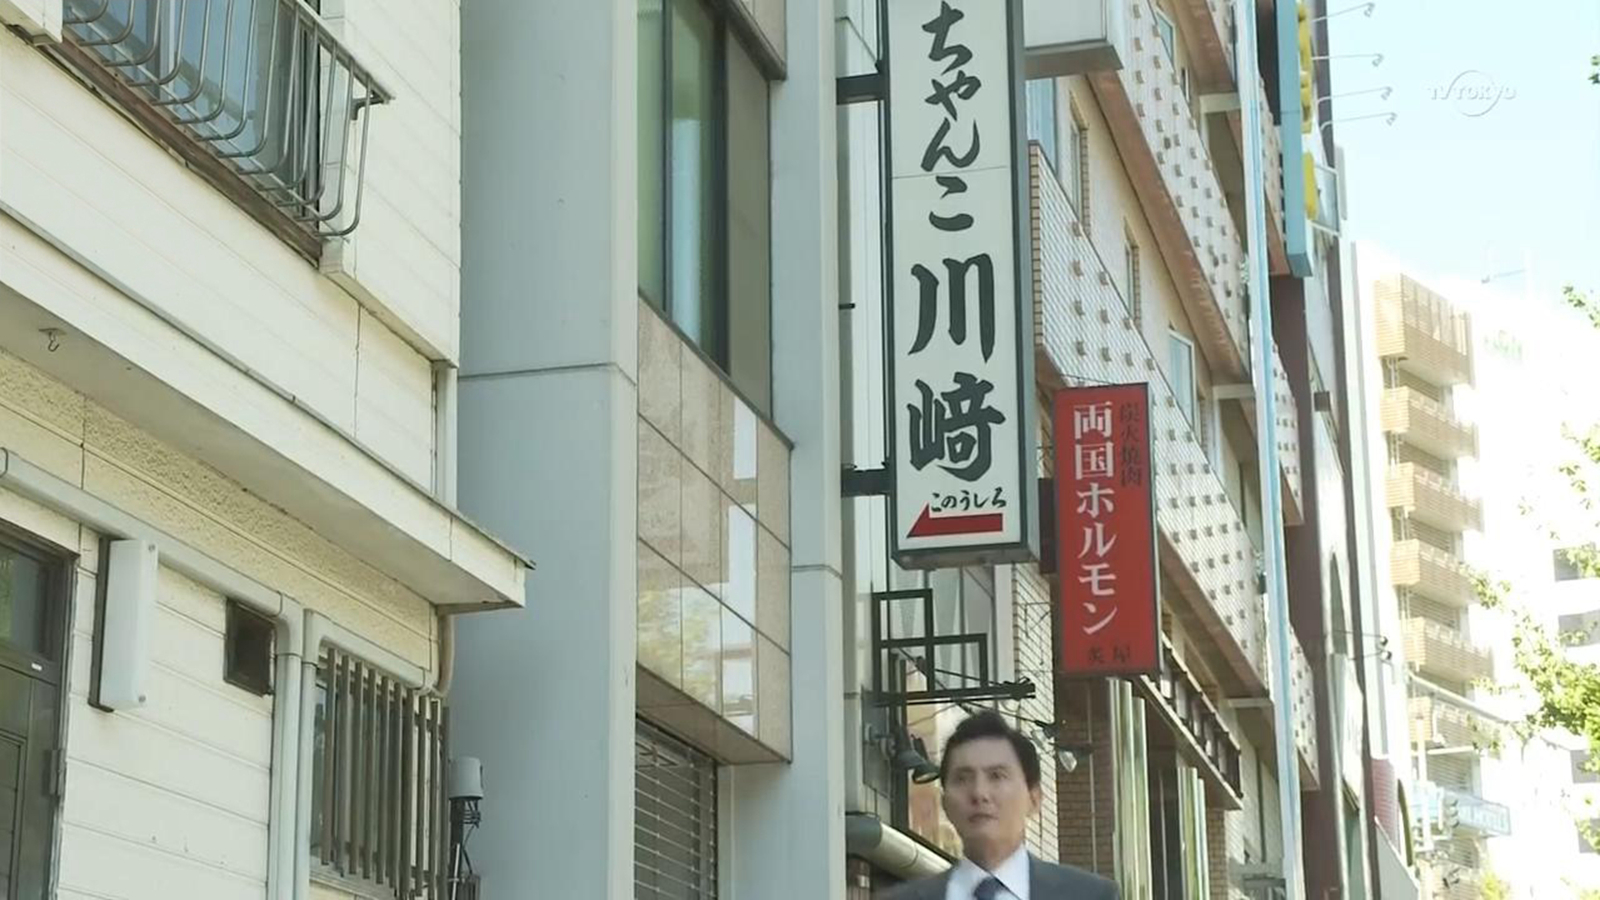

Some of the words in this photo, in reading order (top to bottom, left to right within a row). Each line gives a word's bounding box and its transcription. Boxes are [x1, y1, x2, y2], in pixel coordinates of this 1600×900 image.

[931, 486, 1007, 513] このうしろ
[1073, 401, 1117, 635] 両国ホルモン
